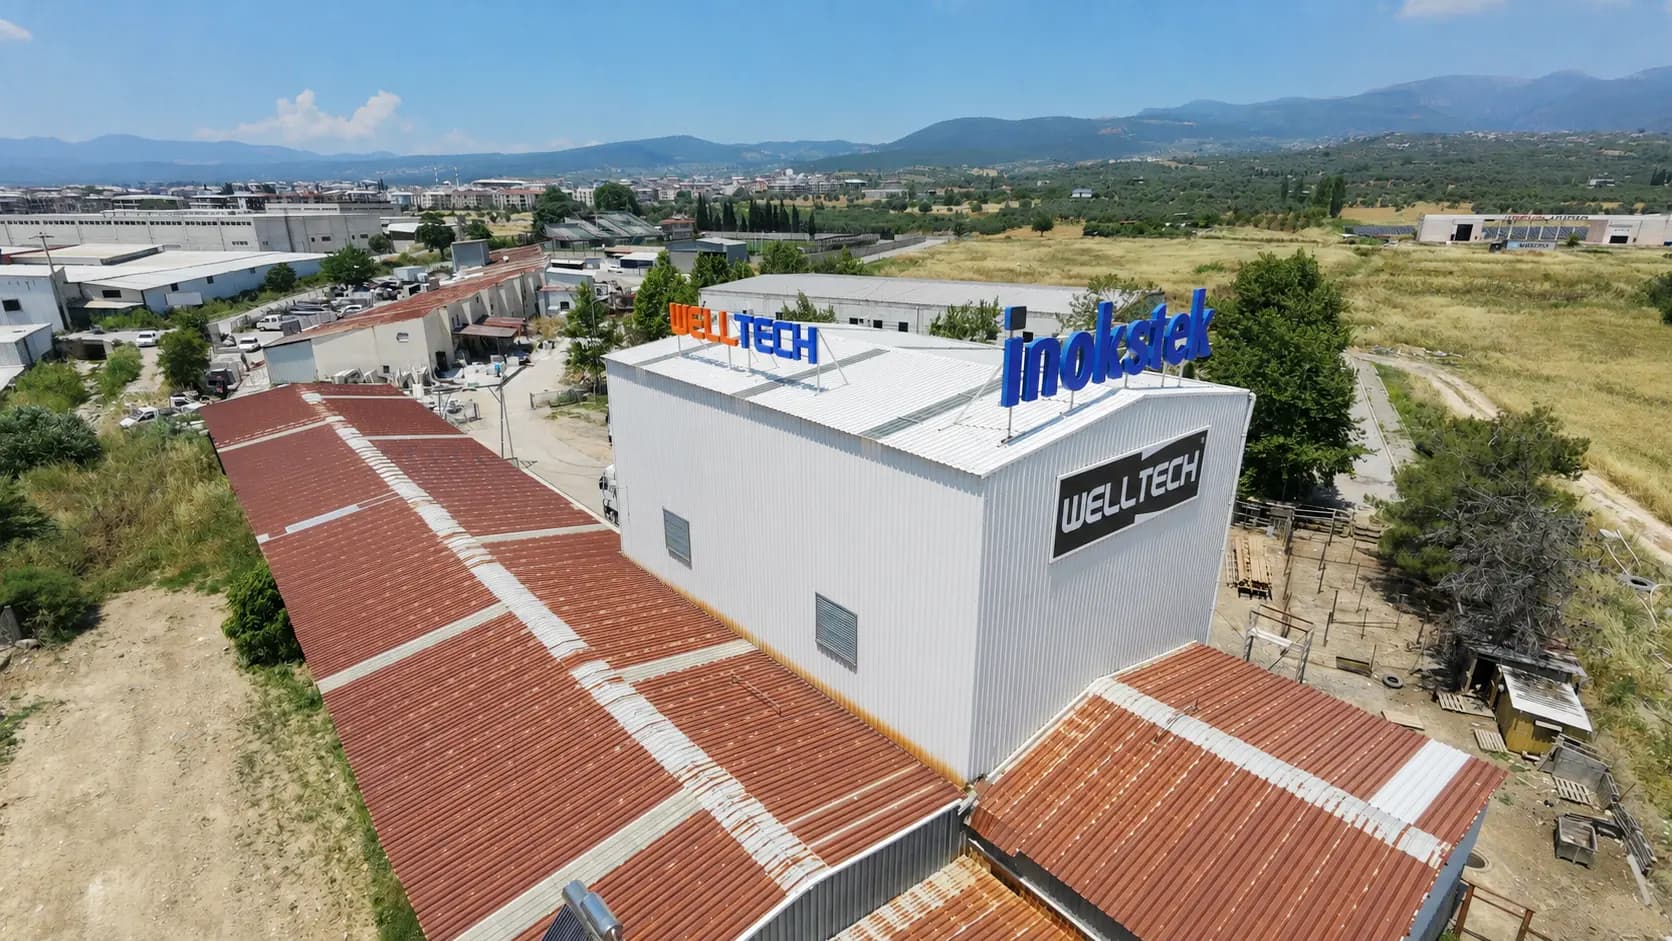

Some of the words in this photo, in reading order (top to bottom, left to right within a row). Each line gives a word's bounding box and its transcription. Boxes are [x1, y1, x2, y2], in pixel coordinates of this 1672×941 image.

[669, 302, 818, 364] WELLTECH
[1000, 288, 1214, 407] inokstek
[1061, 449, 1201, 534] WELLTECH
